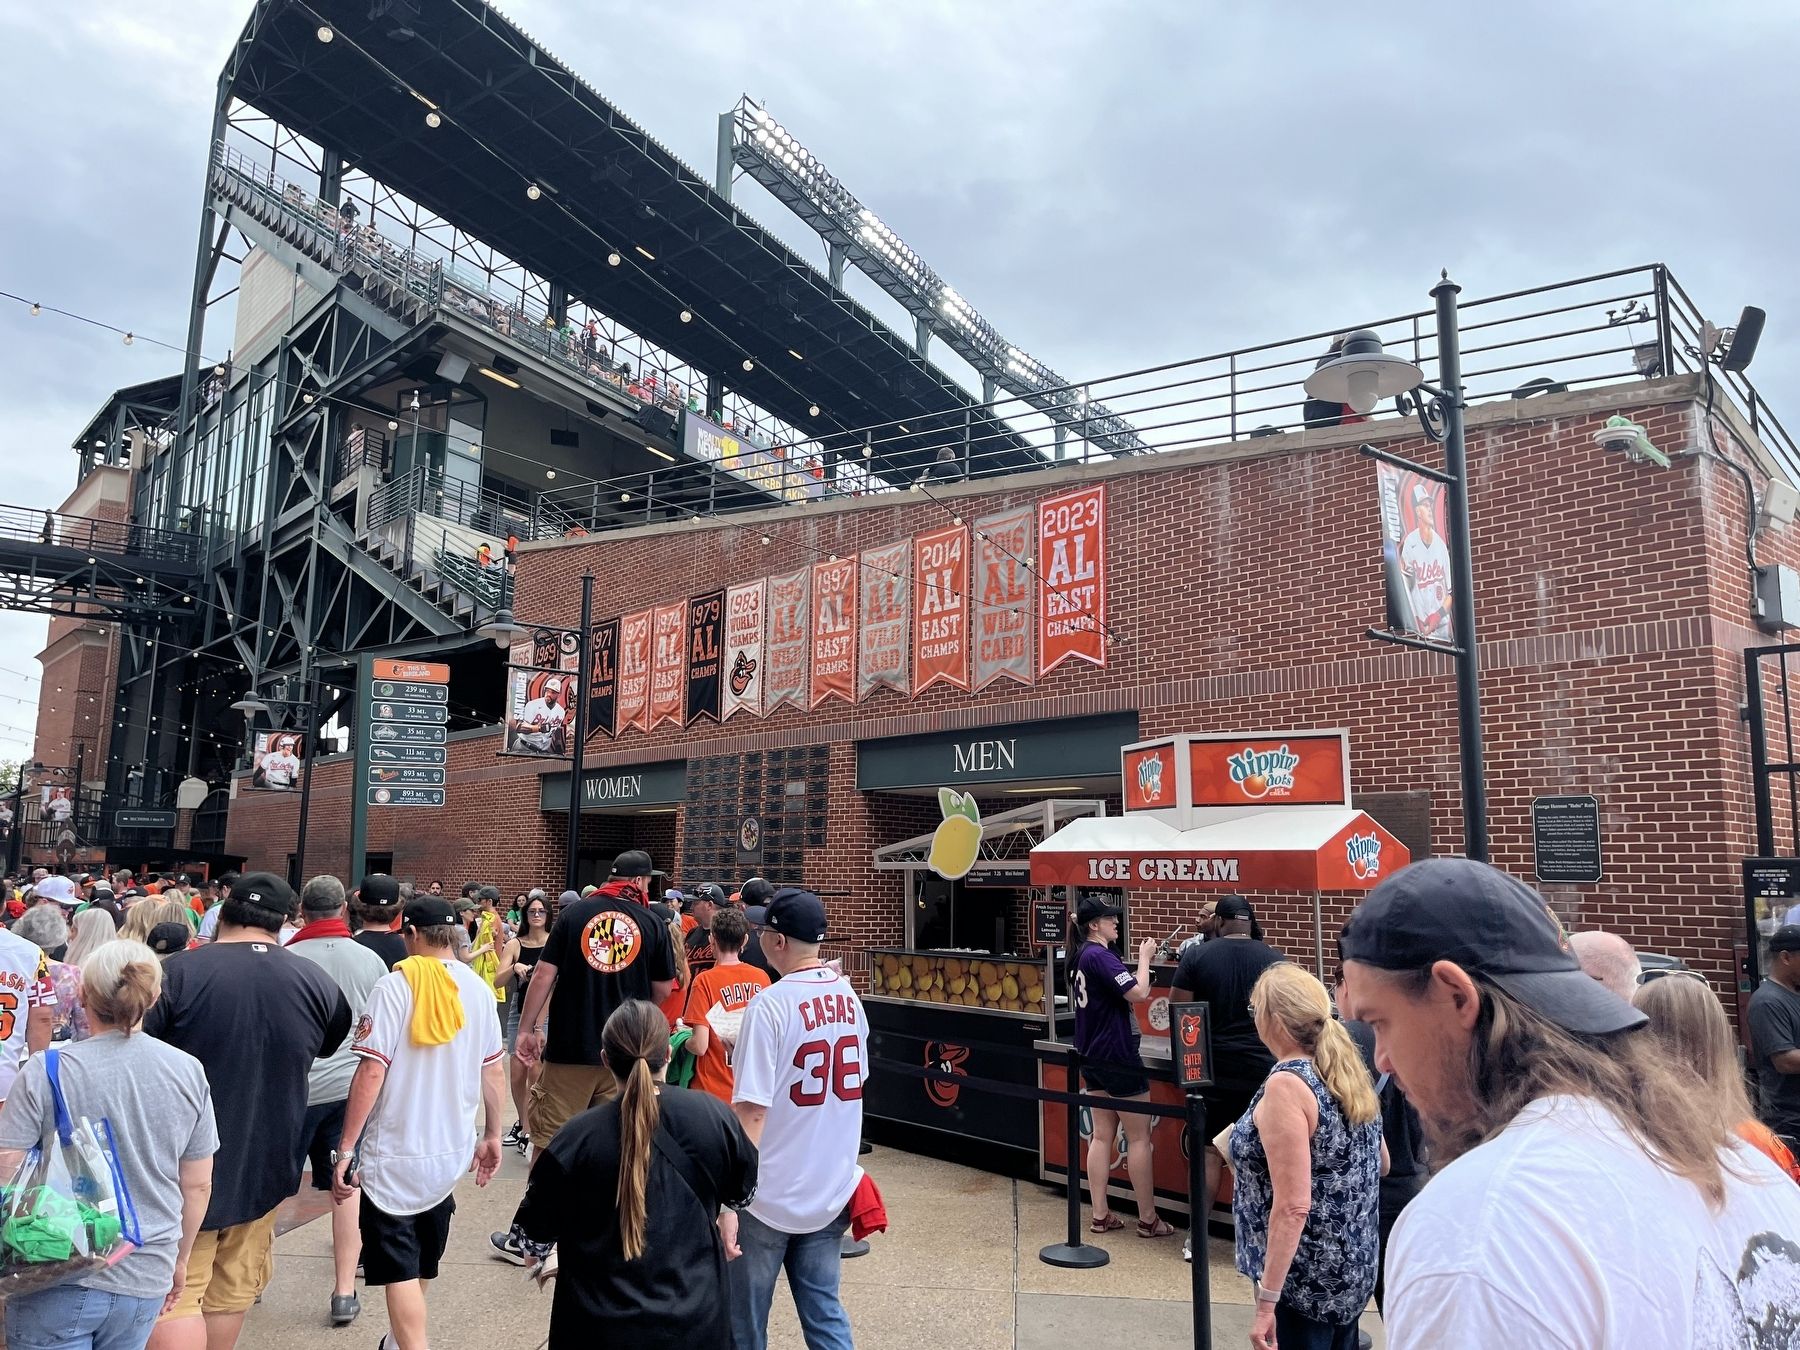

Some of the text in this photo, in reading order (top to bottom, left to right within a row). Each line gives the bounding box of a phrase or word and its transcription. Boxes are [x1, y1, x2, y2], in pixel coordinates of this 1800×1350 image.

[697, 438, 721, 463] NEWS
[1043, 498, 1099, 538] 2023
[921, 537, 961, 571] 2014
[1047, 534, 1095, 588] AL
[817, 566, 852, 596] 1997
[921, 568, 961, 616] AL
[983, 559, 1026, 608] AL
[730, 590, 760, 615] 1983
[867, 579, 902, 625] AL
[1047, 584, 1095, 617] EAST
[656, 610, 682, 633] 1974
[692, 600, 721, 627] 1979
[730, 613, 760, 633] WORLD
[771, 604, 803, 645] AL
[817, 594, 850, 635] AL
[982, 607, 1025, 636] WILD
[592, 628, 613, 650] 1971
[623, 619, 647, 642] 1973
[921, 615, 961, 642] EAST
[1047, 615, 1095, 638] CHAMPS
[656, 633, 680, 669] AL
[692, 625, 718, 663] AL
[730, 631, 760, 649] CHAMPS
[816, 636, 850, 659] EAST
[921, 640, 960, 660] CHAMPS
[981, 635, 1025, 663] CARD
[535, 643, 557, 665] 1969
[623, 641, 646, 676] AL
[592, 650, 613, 684] AL
[655, 670, 680, 689] EAST
[691, 663, 717, 680] CHAMPS
[816, 659, 849, 676] CHAMPS
[405, 685, 418, 693] 239
[513, 672, 528, 722] SANTANDER
[591, 685, 613, 699] CHAMPS
[622, 676, 646, 696] EAST
[654, 689, 679, 704] CHAMPS
[407, 706, 416, 714] 33
[620, 697, 645, 710] CHAMPS
[407, 727, 415, 735] 35
[953, 739, 1017, 773] MEN
[585, 775, 643, 801] WOMEN
[1266, 774, 1292, 787] dots
[1088, 858, 1239, 882] ICE CREAM
[587, 911, 640, 936] BALTIMORE
[587, 955, 627, 972] ORIOLES
[720, 982, 762, 1007] HAYS
[798, 994, 856, 1032] CASAS
[789, 1034, 863, 1107] 36
[1184, 1053, 1201, 1066] ENTER
[1186, 1067, 1202, 1080] HERE
